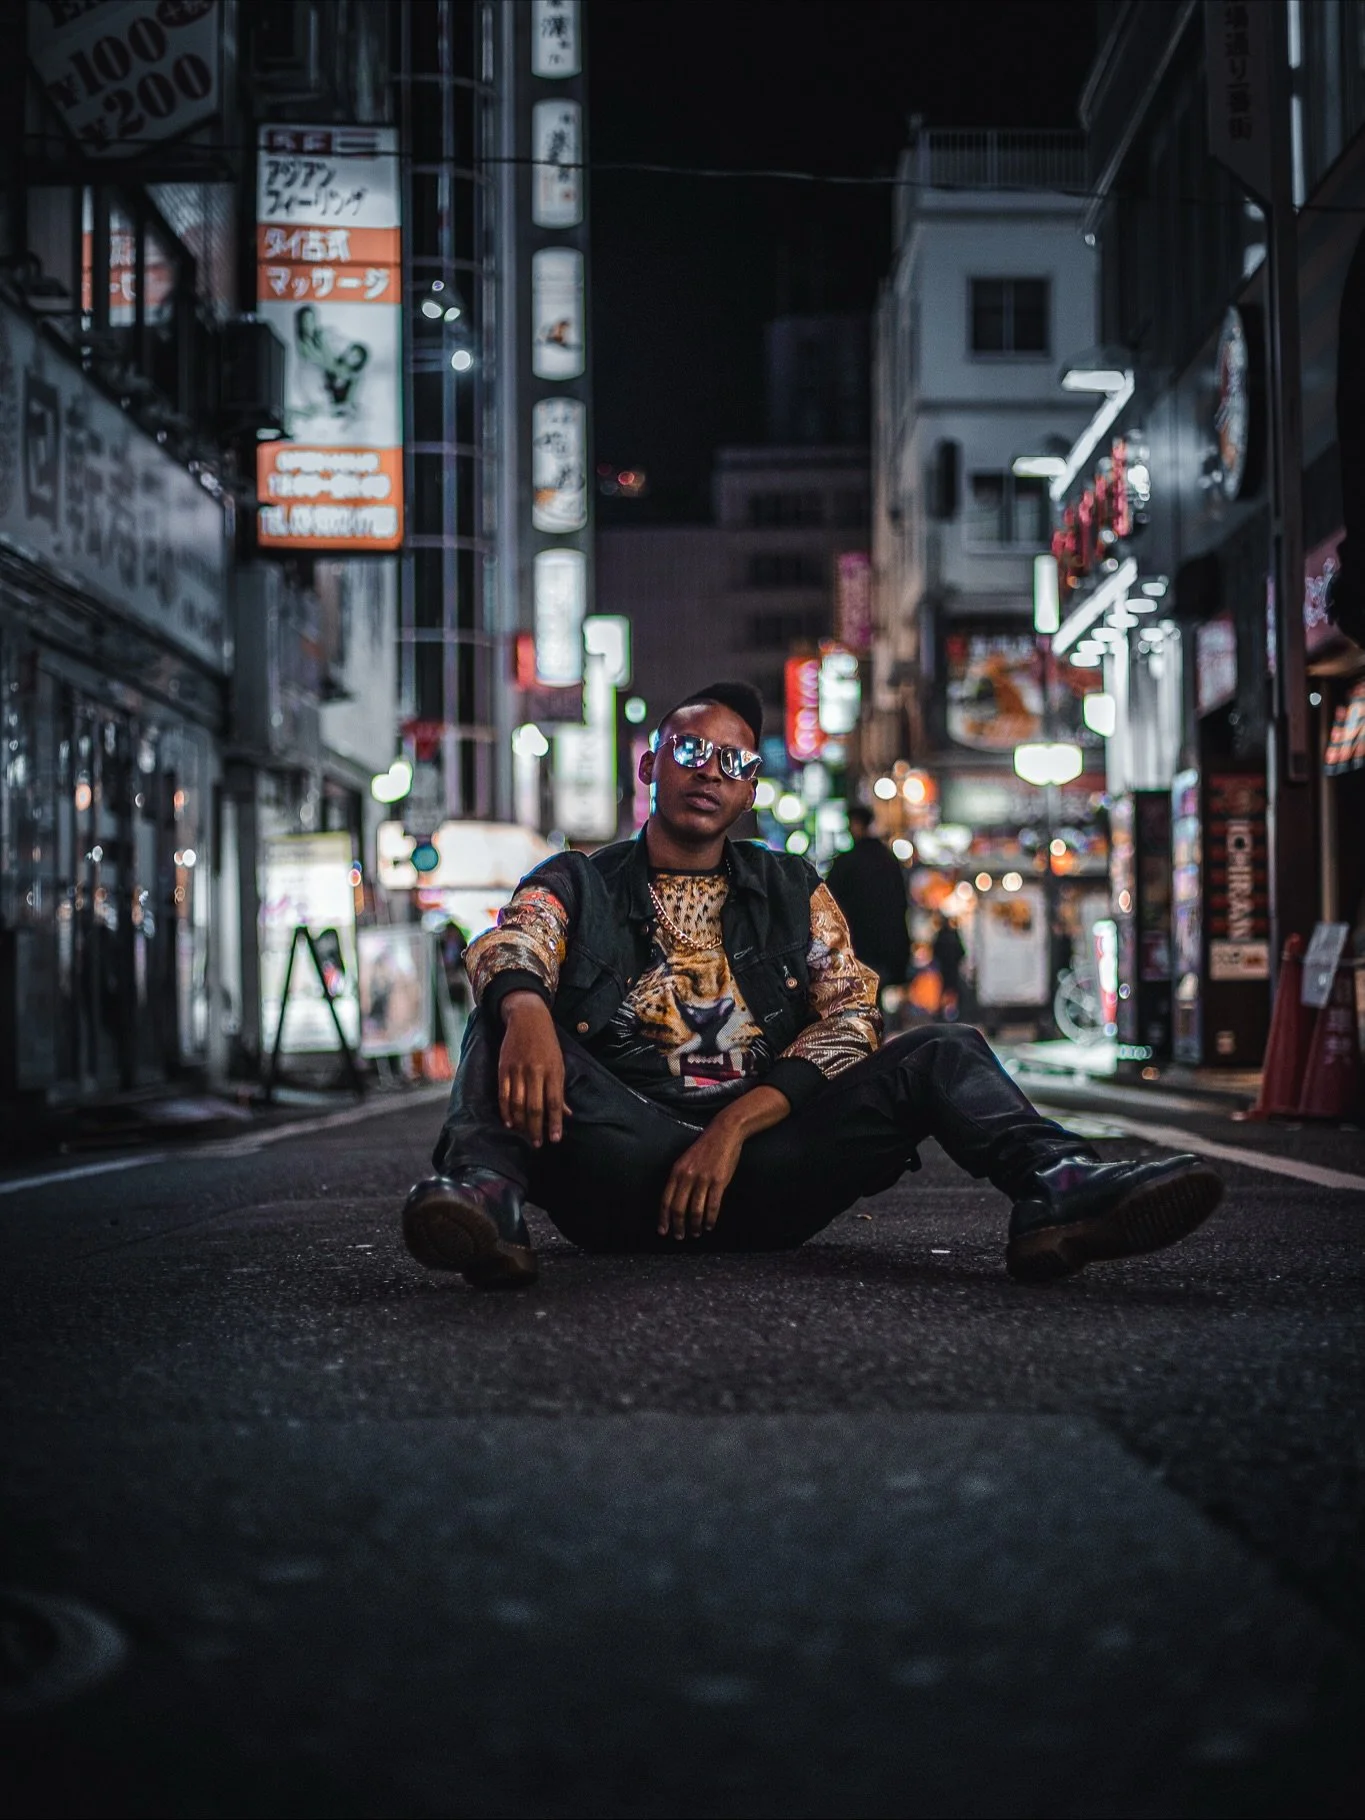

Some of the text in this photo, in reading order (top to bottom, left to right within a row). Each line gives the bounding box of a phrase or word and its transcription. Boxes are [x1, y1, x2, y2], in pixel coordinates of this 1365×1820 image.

[47, 16, 167, 110] ¥100
[81, 53, 212, 151] ¥200
[266, 159, 336, 188] アジアン
[264, 227, 352, 263] タイ古式
[266, 265, 391, 300] マッサージ
